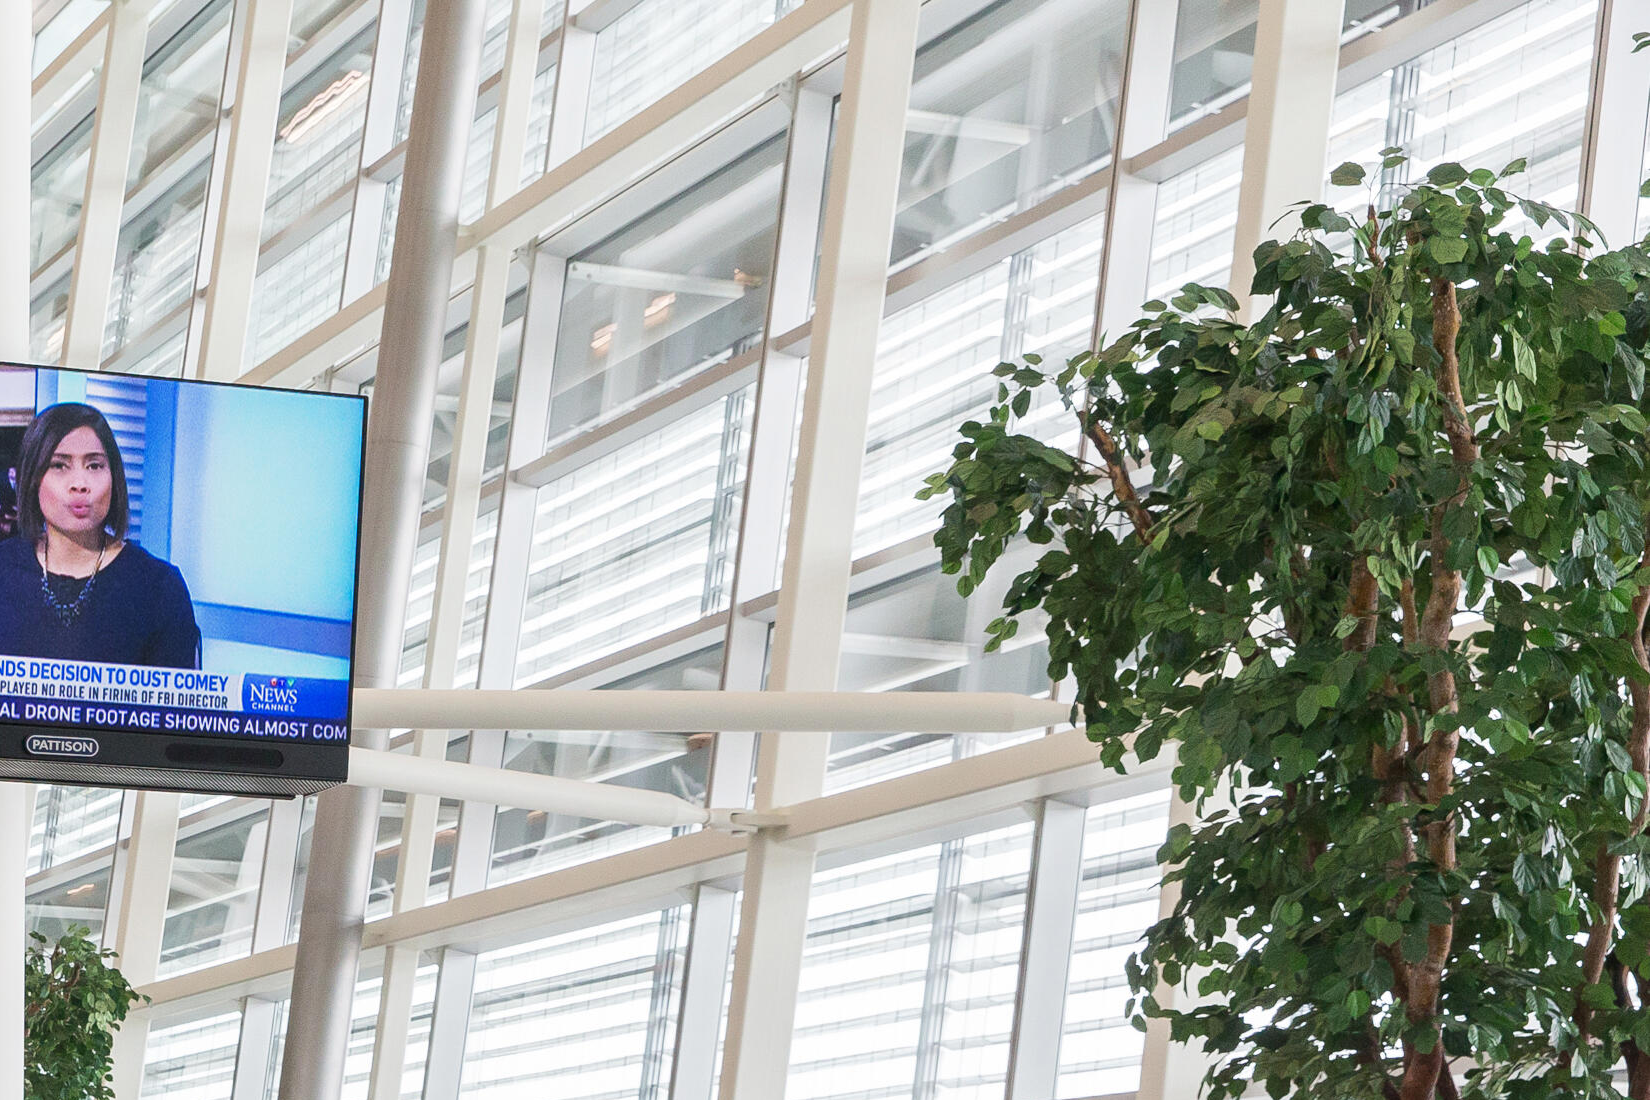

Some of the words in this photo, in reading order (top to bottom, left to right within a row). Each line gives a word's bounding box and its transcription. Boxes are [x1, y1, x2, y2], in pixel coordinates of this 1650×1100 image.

[30, 661, 102, 684] DECISION
[106, 667, 126, 685] TO
[129, 669, 171, 689] OUST
[174, 672, 229, 693] COMEY
[0, 680, 38, 696] PLAYED
[41, 682, 56, 697] NO
[59, 684, 85, 699] ROLE
[89, 686, 99, 700] IN
[103, 687, 137, 703] FIRING
[141, 690, 154, 704] OF
[158, 691, 175, 706] FBI
[178, 692, 228, 709] DIRECTOR
[250, 683, 298, 705] NEWS
[252, 702, 295, 713] CHANNEL
[25, 703, 81, 723] DRONE
[86, 708, 160, 729] FOOTAGE
[165, 713, 240, 734] SHOWING
[244, 718, 309, 739] ALMOST
[313, 723, 347, 741] COM
[32, 739, 94, 753] PATTISON
